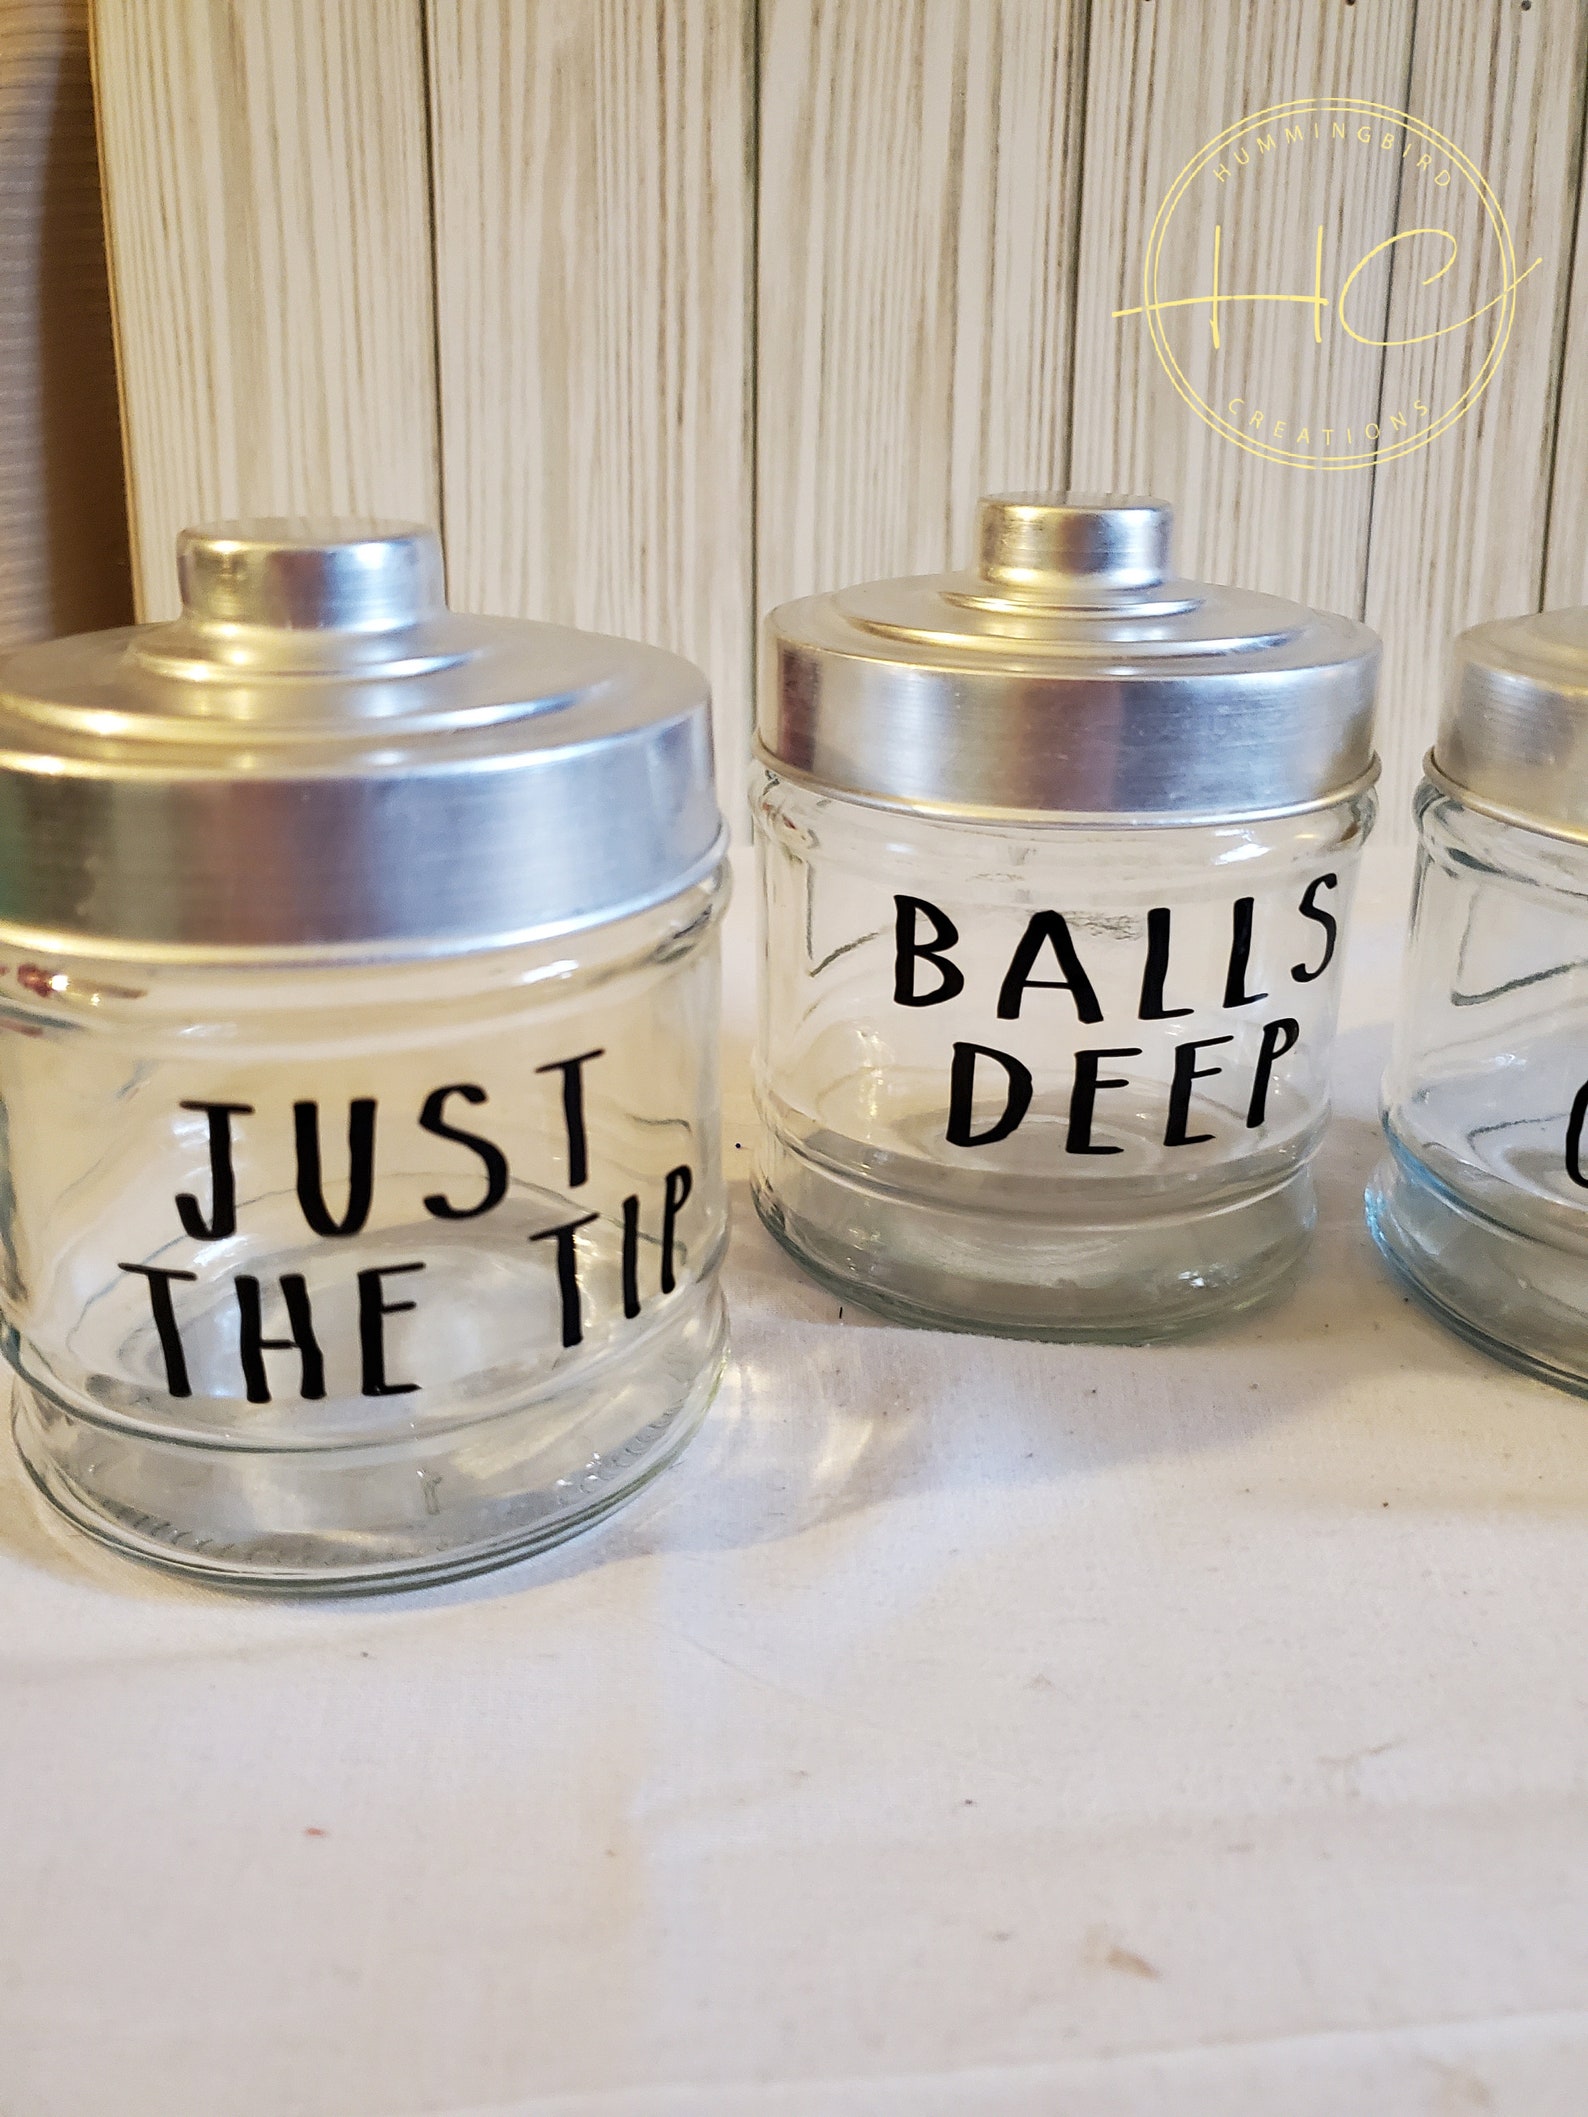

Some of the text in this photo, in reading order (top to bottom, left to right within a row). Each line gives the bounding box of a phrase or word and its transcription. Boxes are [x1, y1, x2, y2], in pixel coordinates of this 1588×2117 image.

[893, 873, 1338, 1024] BALLS
[175, 1049, 605, 1241] JUST
[945, 1017, 1300, 1155] DEEP
[118, 1164, 692, 1404] THE TIP
